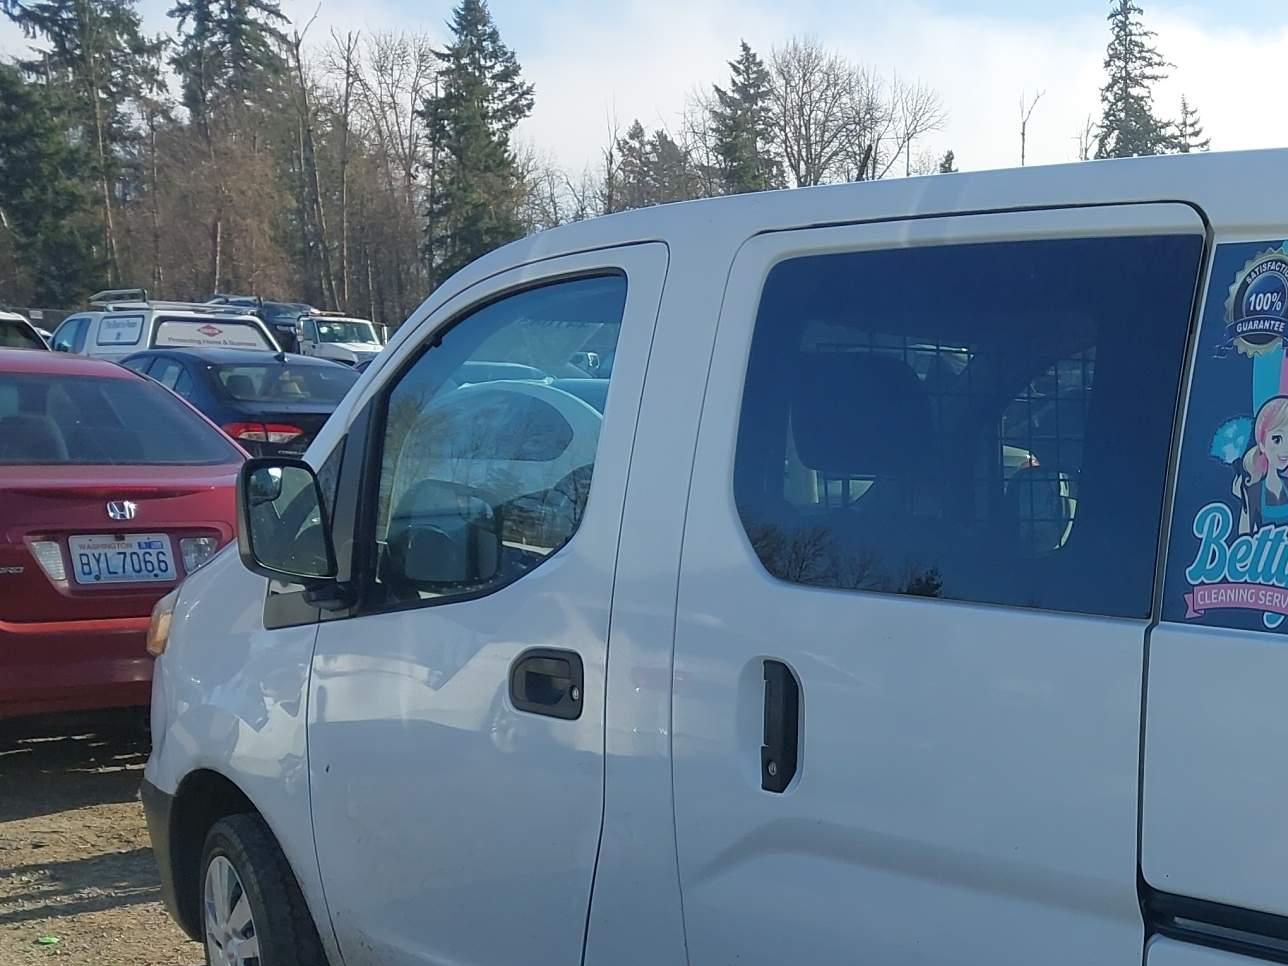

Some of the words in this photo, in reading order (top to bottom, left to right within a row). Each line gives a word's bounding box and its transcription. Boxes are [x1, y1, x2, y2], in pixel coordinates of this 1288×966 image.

[1249, 292, 1282, 311] 100%
[1236, 320, 1286, 333] GUARANTEE
[79, 551, 169, 575] BYL7066
[1198, 588, 1256, 605] CLEANING
